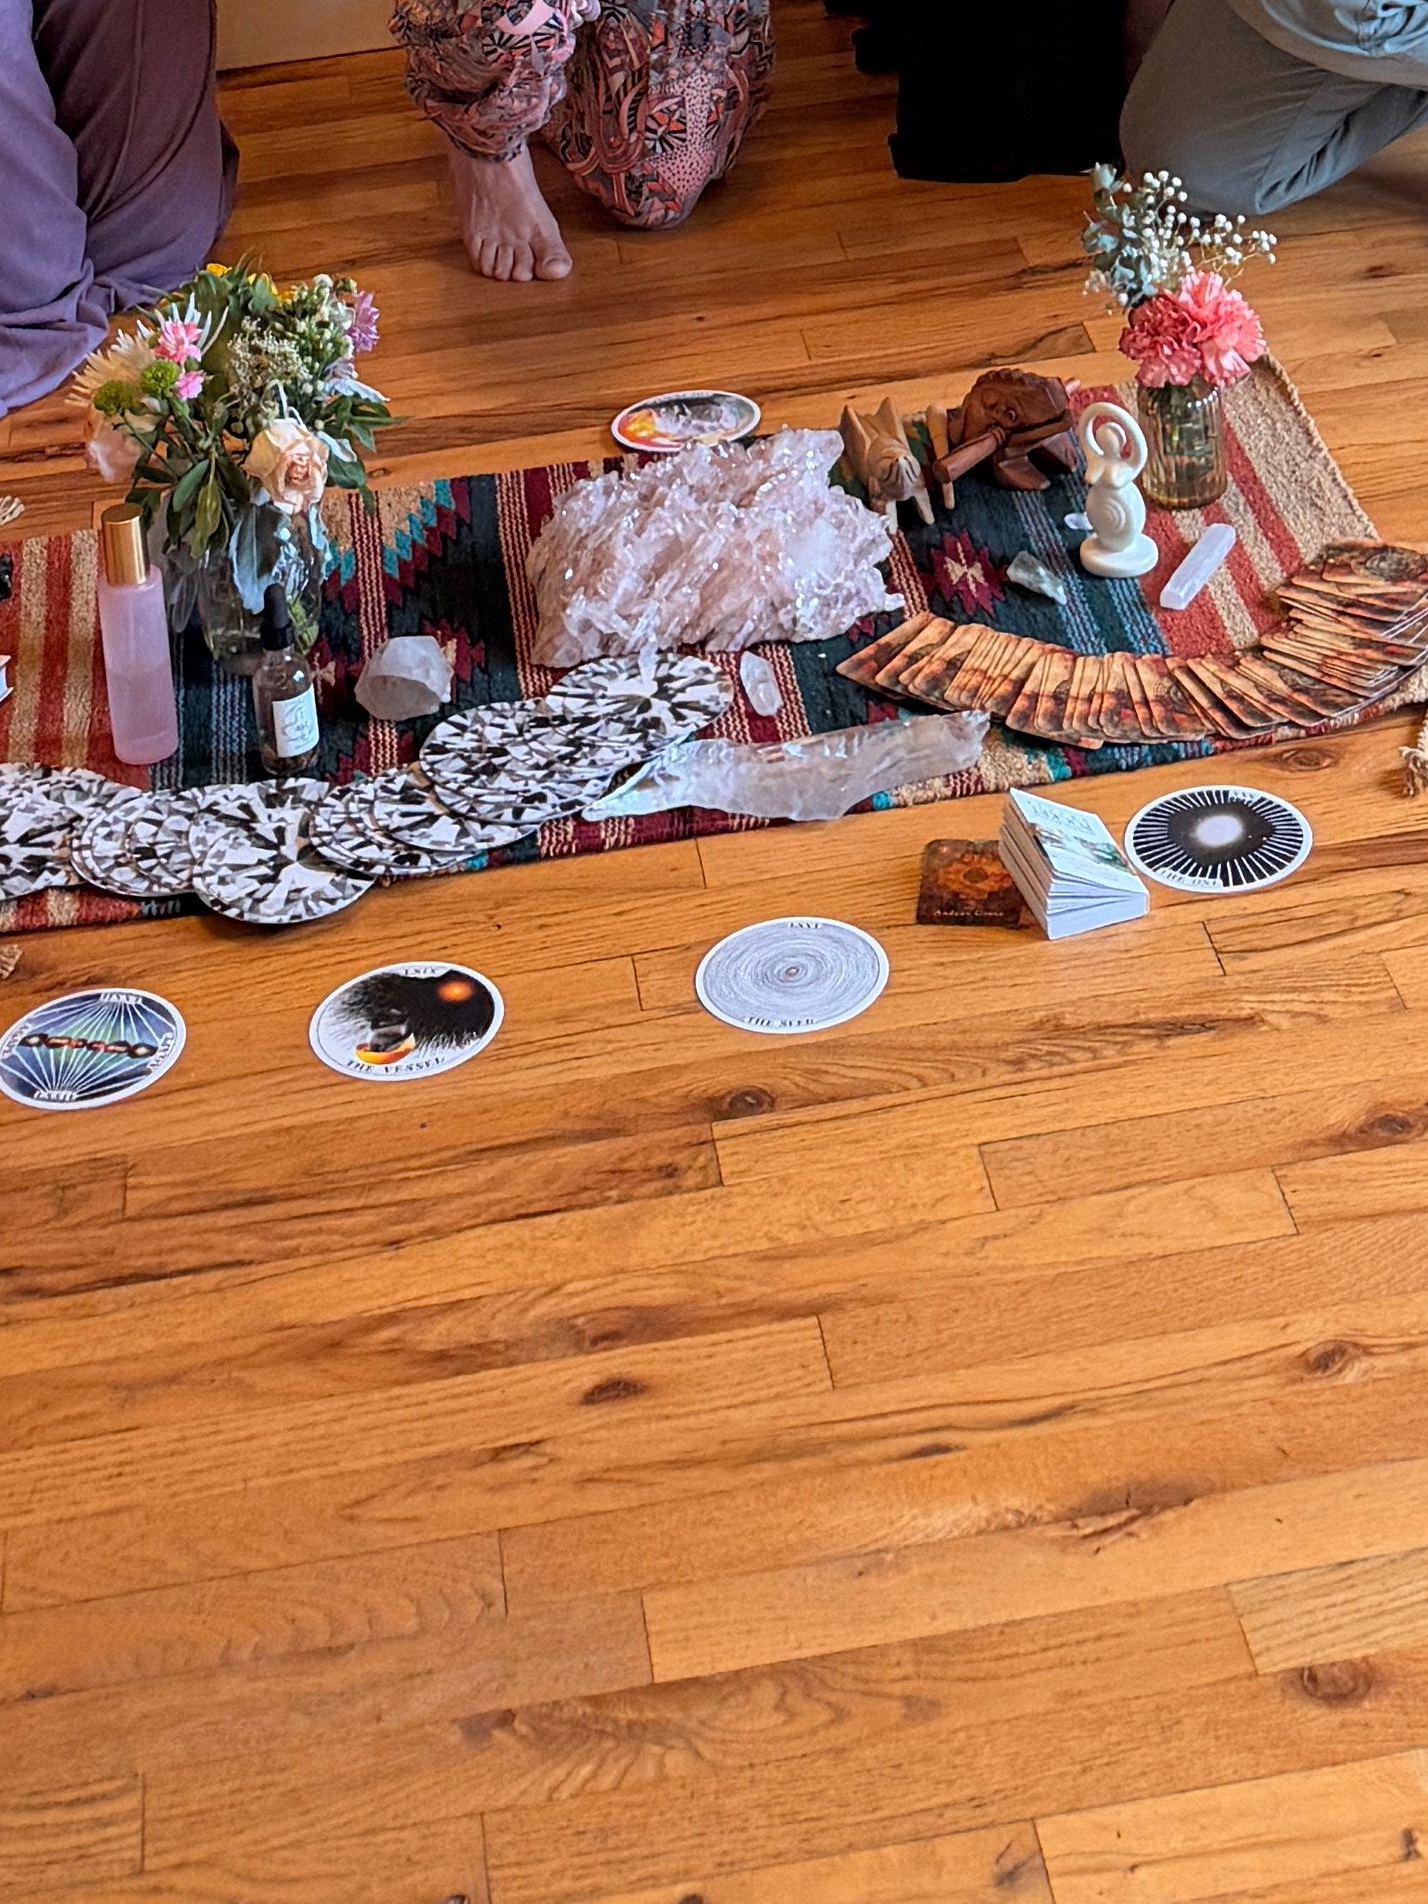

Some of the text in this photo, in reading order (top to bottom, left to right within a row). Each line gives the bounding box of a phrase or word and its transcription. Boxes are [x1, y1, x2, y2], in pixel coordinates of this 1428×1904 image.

[747, 1016, 773, 1027] THE
[347, 1056, 445, 1073] THE VESSEL
